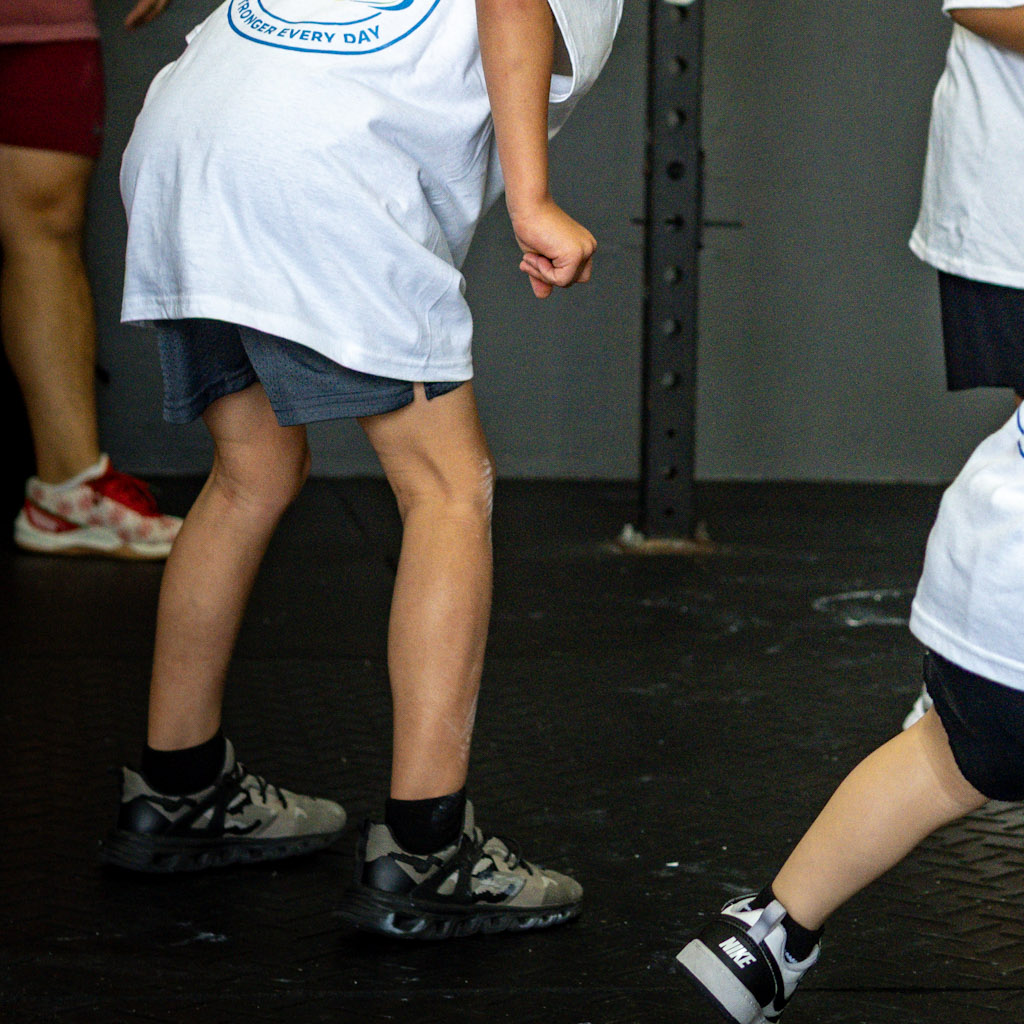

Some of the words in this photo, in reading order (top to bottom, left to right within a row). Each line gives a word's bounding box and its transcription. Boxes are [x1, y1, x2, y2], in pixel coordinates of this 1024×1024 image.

[276, 27, 337, 44] EVERY
[343, 25, 381, 45] DAY
[718, 936, 757, 969] NIKE
